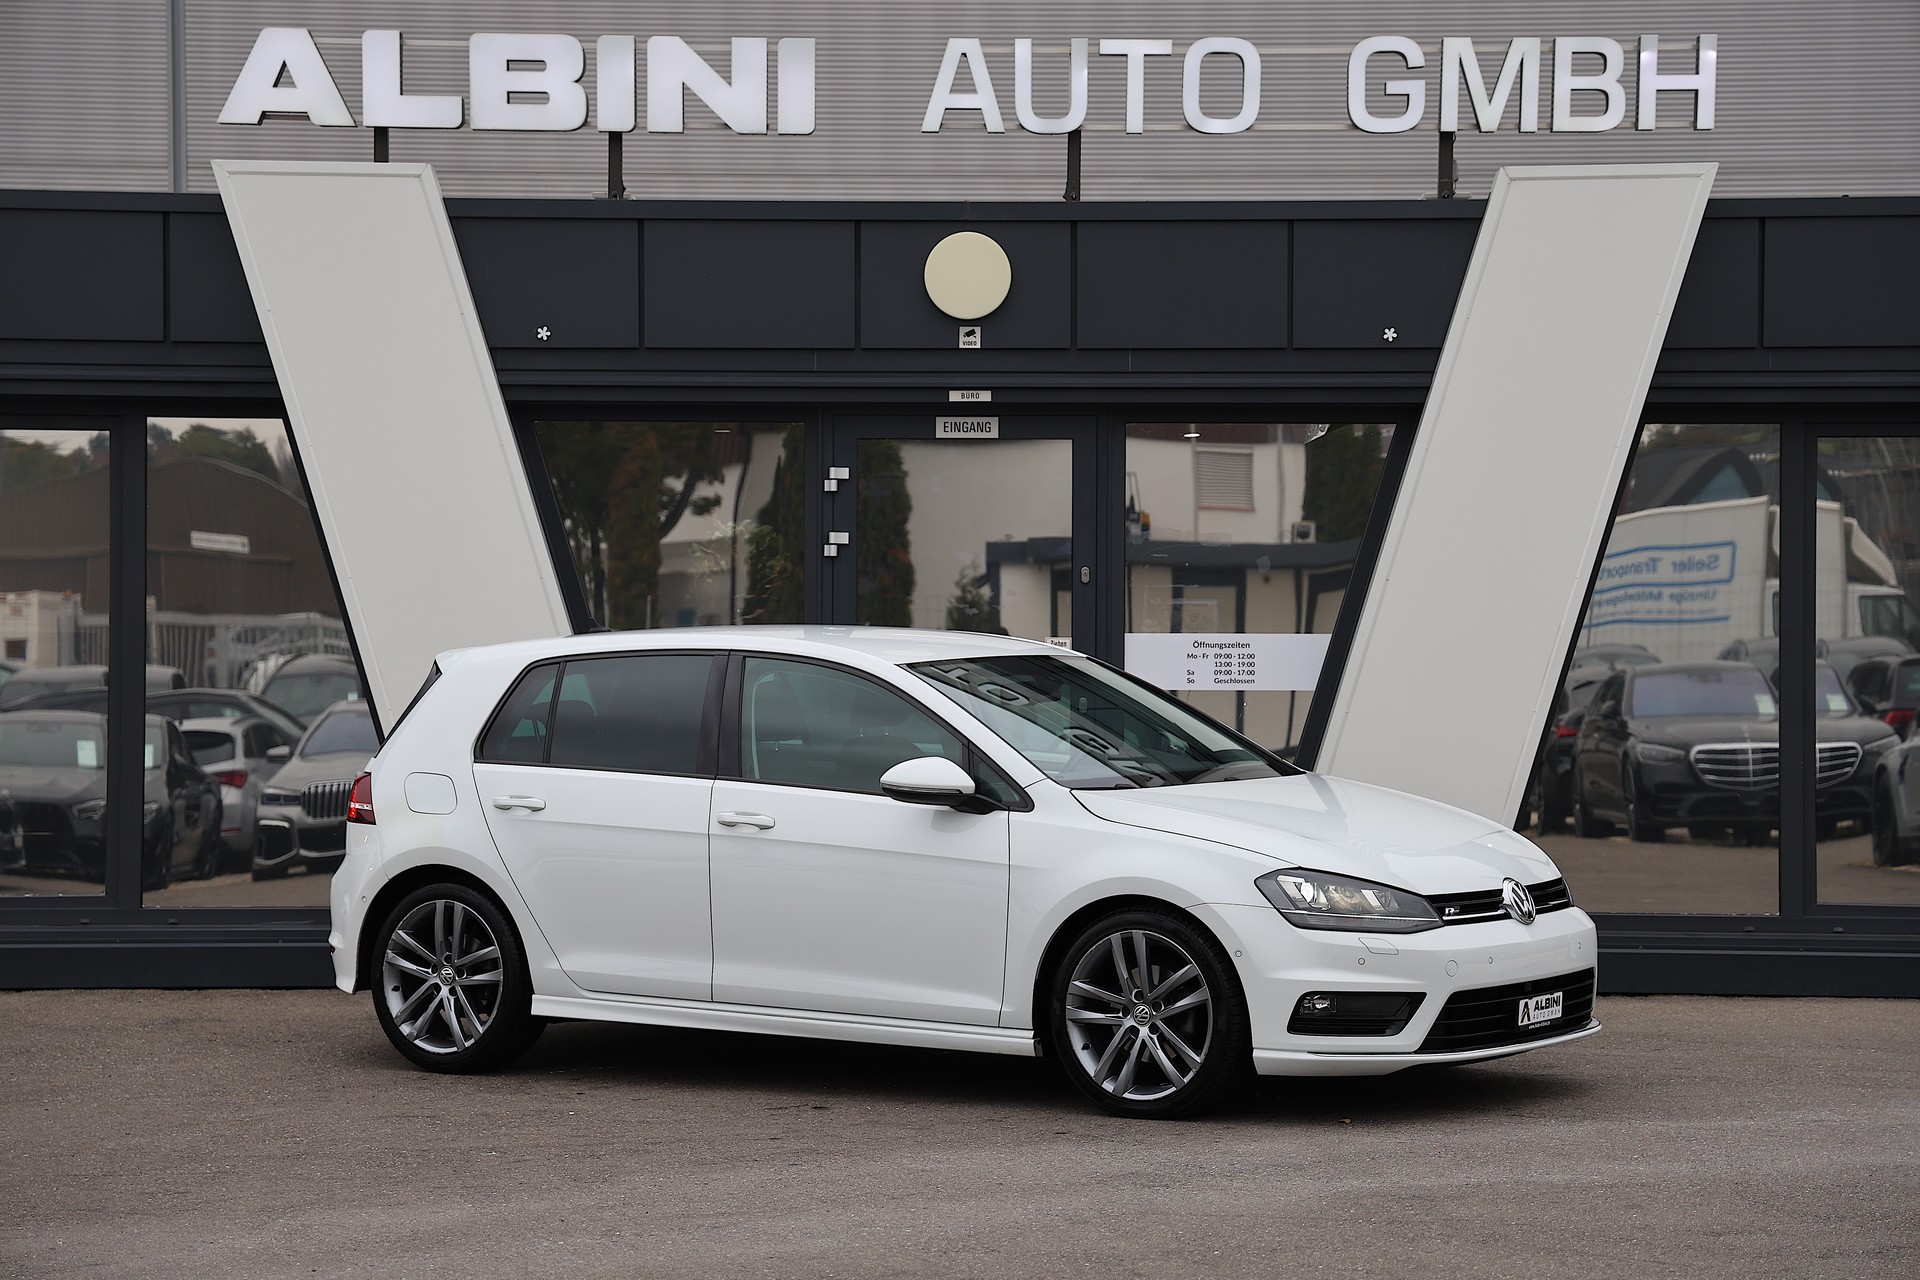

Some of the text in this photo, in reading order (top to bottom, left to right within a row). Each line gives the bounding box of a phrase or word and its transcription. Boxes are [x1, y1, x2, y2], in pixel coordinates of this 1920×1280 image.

[217, 27, 1718, 135] ALBINI AUTO GMBH
[960, 391, 980, 399] BÜRO
[943, 421, 992, 433] EINGANG
[1192, 640, 1251, 650] Öffnungszeiten
[1533, 994, 1561, 1012] ALBINI
